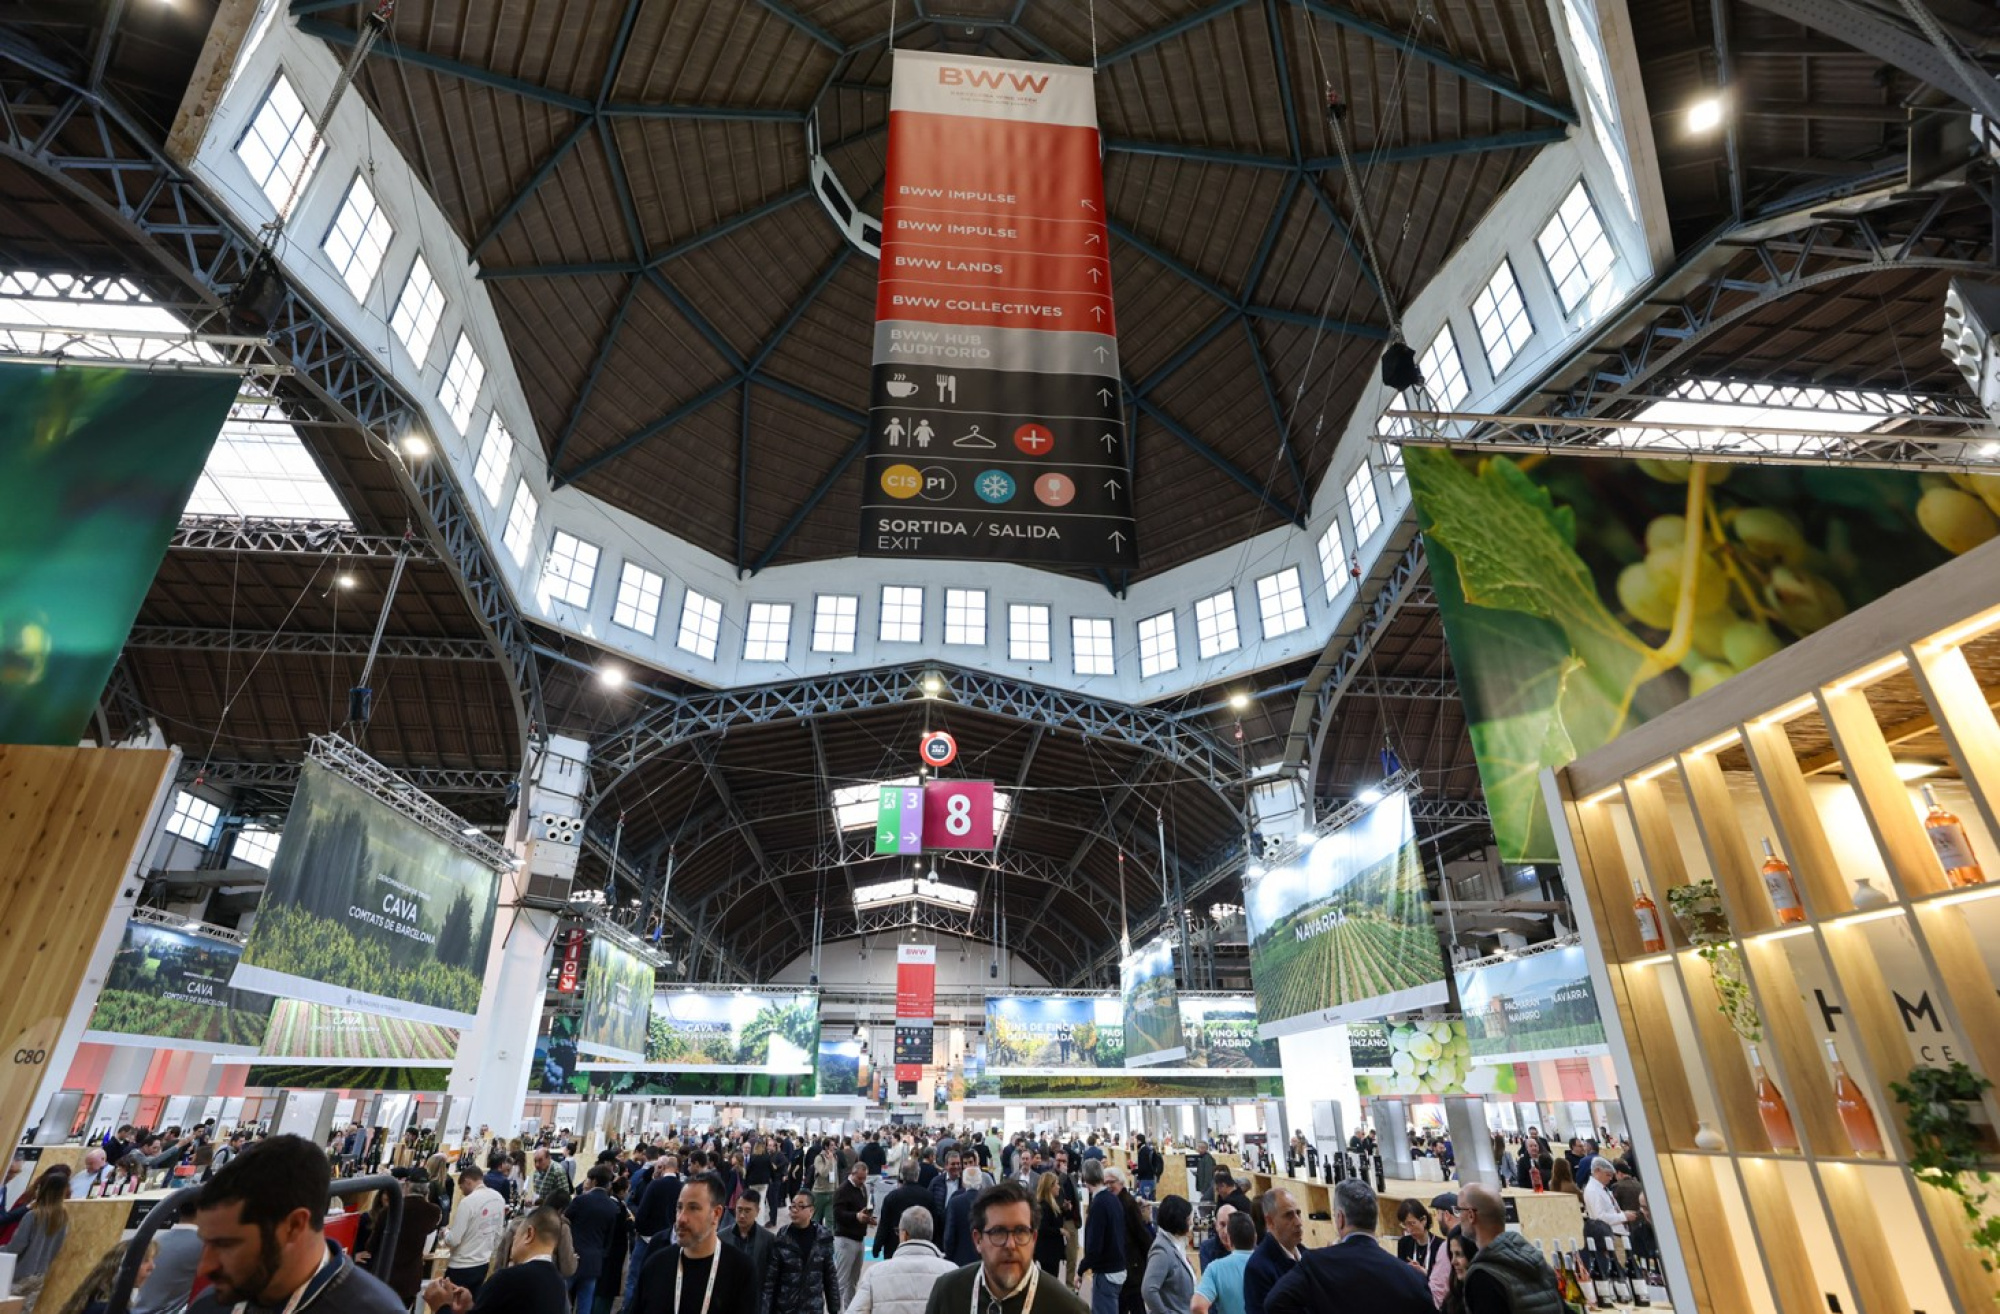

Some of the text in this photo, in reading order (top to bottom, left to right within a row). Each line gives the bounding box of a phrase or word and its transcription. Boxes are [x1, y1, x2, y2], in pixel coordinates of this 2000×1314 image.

[939, 66, 1049, 94] BWW
[899, 186, 1016, 203] BWW IMPULSE
[897, 220, 1017, 239] BWW IMPULSE
[895, 256, 1003, 274] BWW LANDS
[893, 295, 1062, 317] BWW COLLECTIVES
[890, 329, 982, 345] BWW HUB
[889, 343, 991, 359] AUDITORIO
[887, 475, 916, 488] CIS
[926, 477, 945, 490] P1
[878, 519, 967, 535] SORTIDA
[988, 524, 1060, 539] SALIDA
[878, 536, 922, 550] EXIT
[906, 792, 918, 809] 3
[945, 794, 972, 836] 8
[382, 893, 417, 923] CAVA
[348, 905, 436, 945] COMTATS DE BARCELONA
[1295, 908, 1347, 943] NAVARRA
[187, 981, 213, 997] CAVA
[1552, 989, 1588, 1003] NAVARRA
[1508, 1010, 1541, 1023] NAVARRO
[686, 1023, 714, 1032] CAVA
[1028, 1022, 1043, 1032] DE
[1046, 1022, 1077, 1032] FINCA
[1209, 1029, 1253, 1038] VINOS DE
[1369, 1029, 1382, 1037] DE
[1213, 1038, 1251, 1047] MADRID
